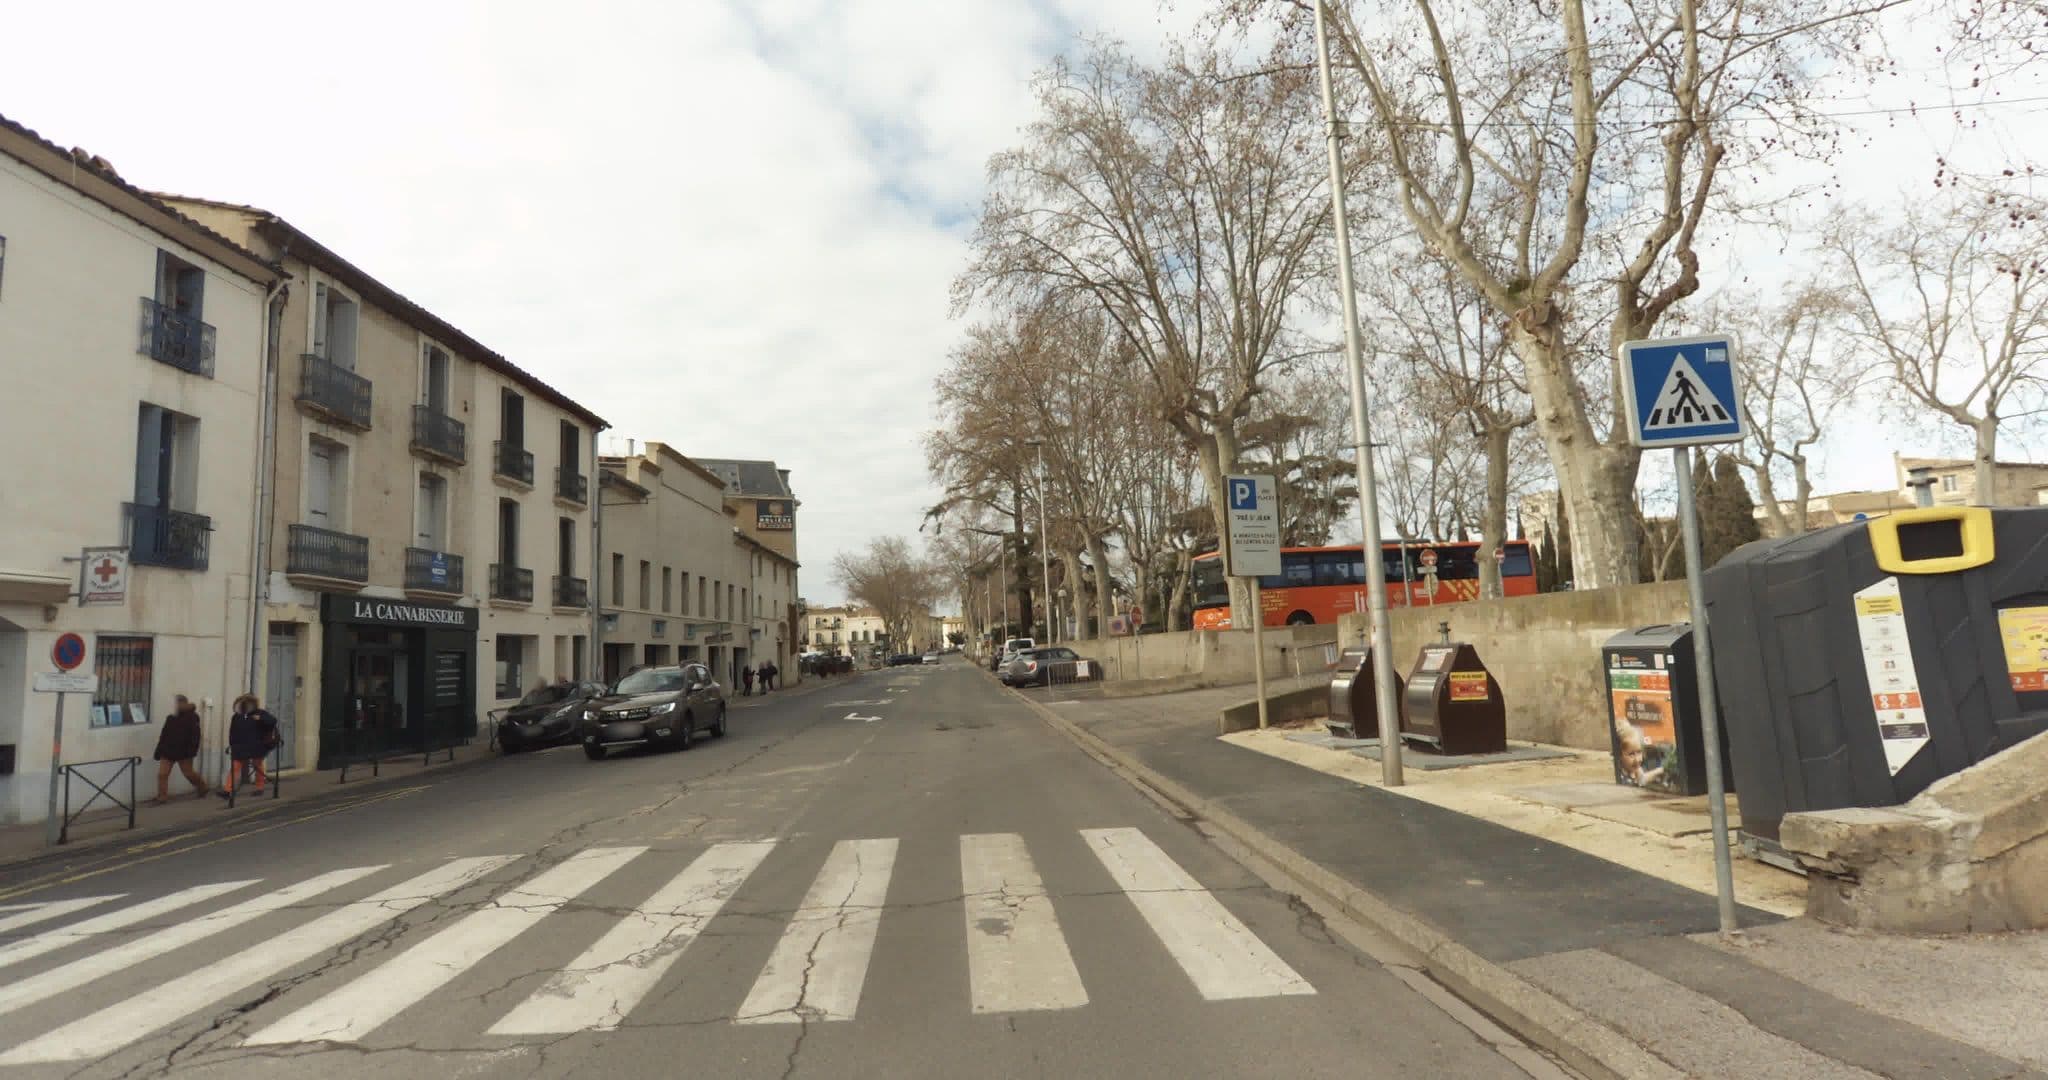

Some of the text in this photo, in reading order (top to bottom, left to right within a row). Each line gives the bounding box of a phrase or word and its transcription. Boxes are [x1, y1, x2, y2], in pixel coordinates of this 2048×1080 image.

[1235, 483, 1250, 506] P
[354, 601, 465, 625] LA CANNABISSERIE
